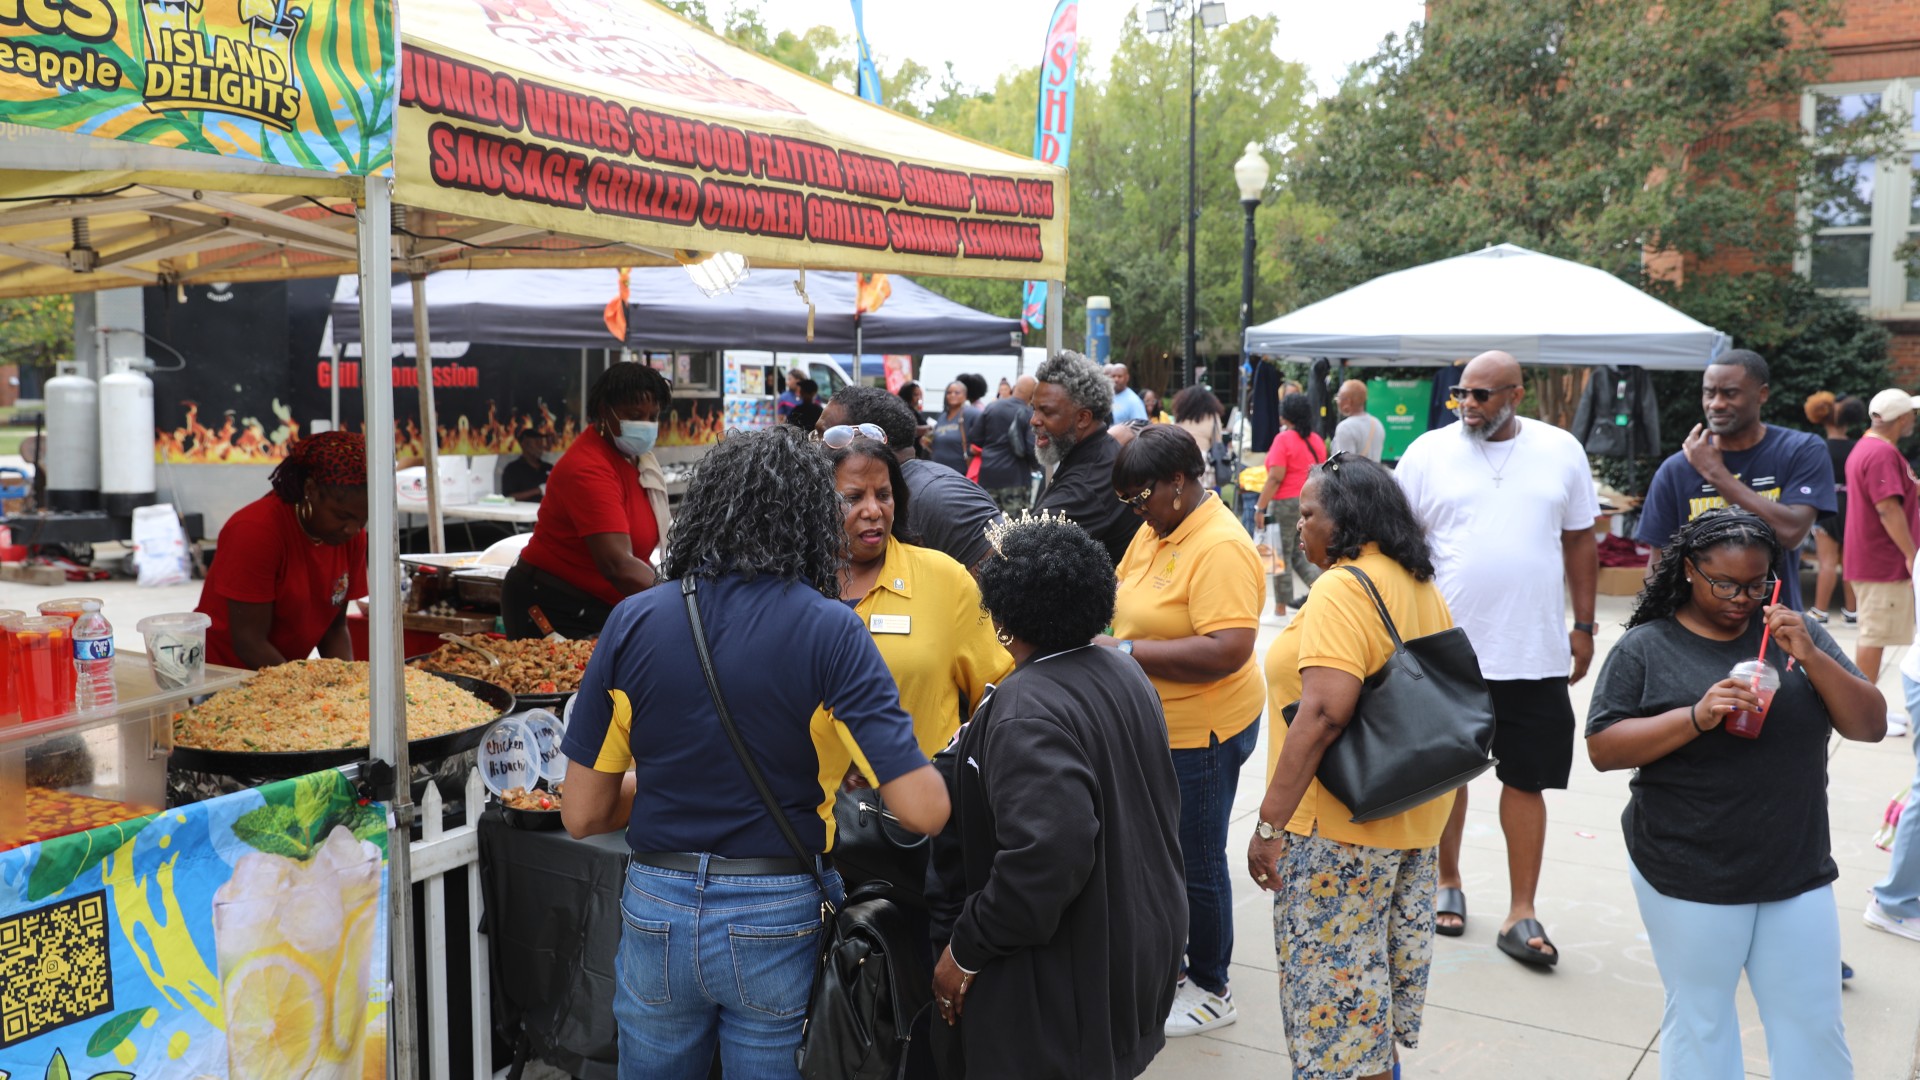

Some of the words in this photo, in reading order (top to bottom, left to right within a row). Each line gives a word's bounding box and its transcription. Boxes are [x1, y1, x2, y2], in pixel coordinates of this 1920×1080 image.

[160, 28, 288, 85] ISLAND
[145, 62, 300, 121] DELIGHTS
[402, 47, 520, 128] JUMBO
[523, 83, 631, 154] WINGS
[632, 110, 747, 173] SEAFOOD
[749, 133, 844, 189] PLATTER
[840, 152, 902, 201] FRIED
[901, 164, 973, 209] SHRIMP
[972, 177, 1021, 215] FRIED
[1017, 180, 1054, 218] FISH
[431, 128, 586, 205] SAUSAGE
[587, 162, 700, 222] GRILLED
[701, 182, 805, 236] CHICKEN
[807, 198, 889, 246] GRILLED
[888, 211, 960, 254] SHRIMP
[959, 220, 1043, 260] LEMONADE
[317, 361, 359, 389] Gill
